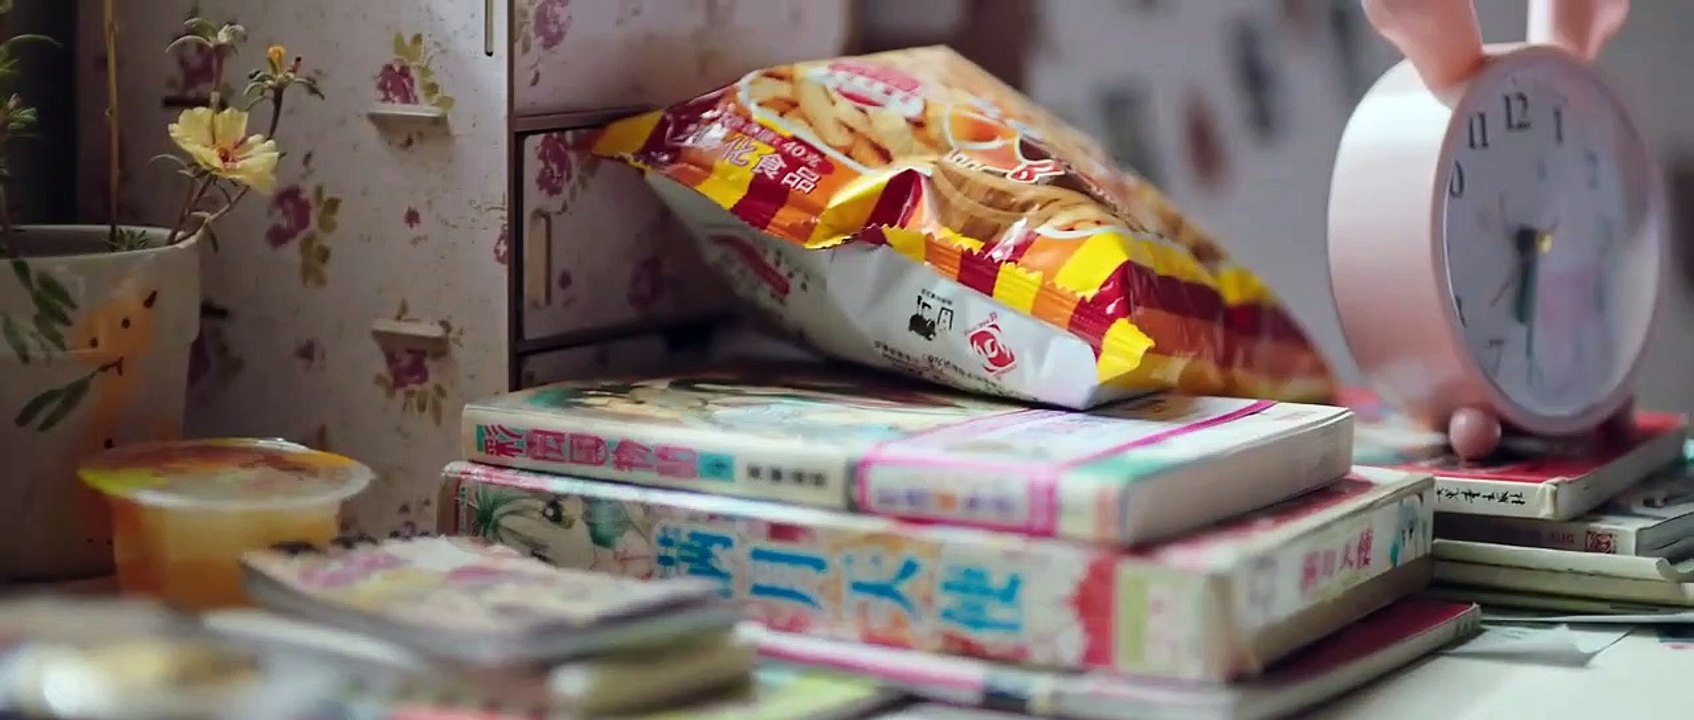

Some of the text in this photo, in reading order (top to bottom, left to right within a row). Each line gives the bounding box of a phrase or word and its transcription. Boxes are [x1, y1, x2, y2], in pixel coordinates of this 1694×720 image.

[1503, 91, 1532, 130] 12
[1468, 111, 1489, 149] 11
[702, 122, 822, 193] 化食品
[1449, 160, 1465, 198] 0
